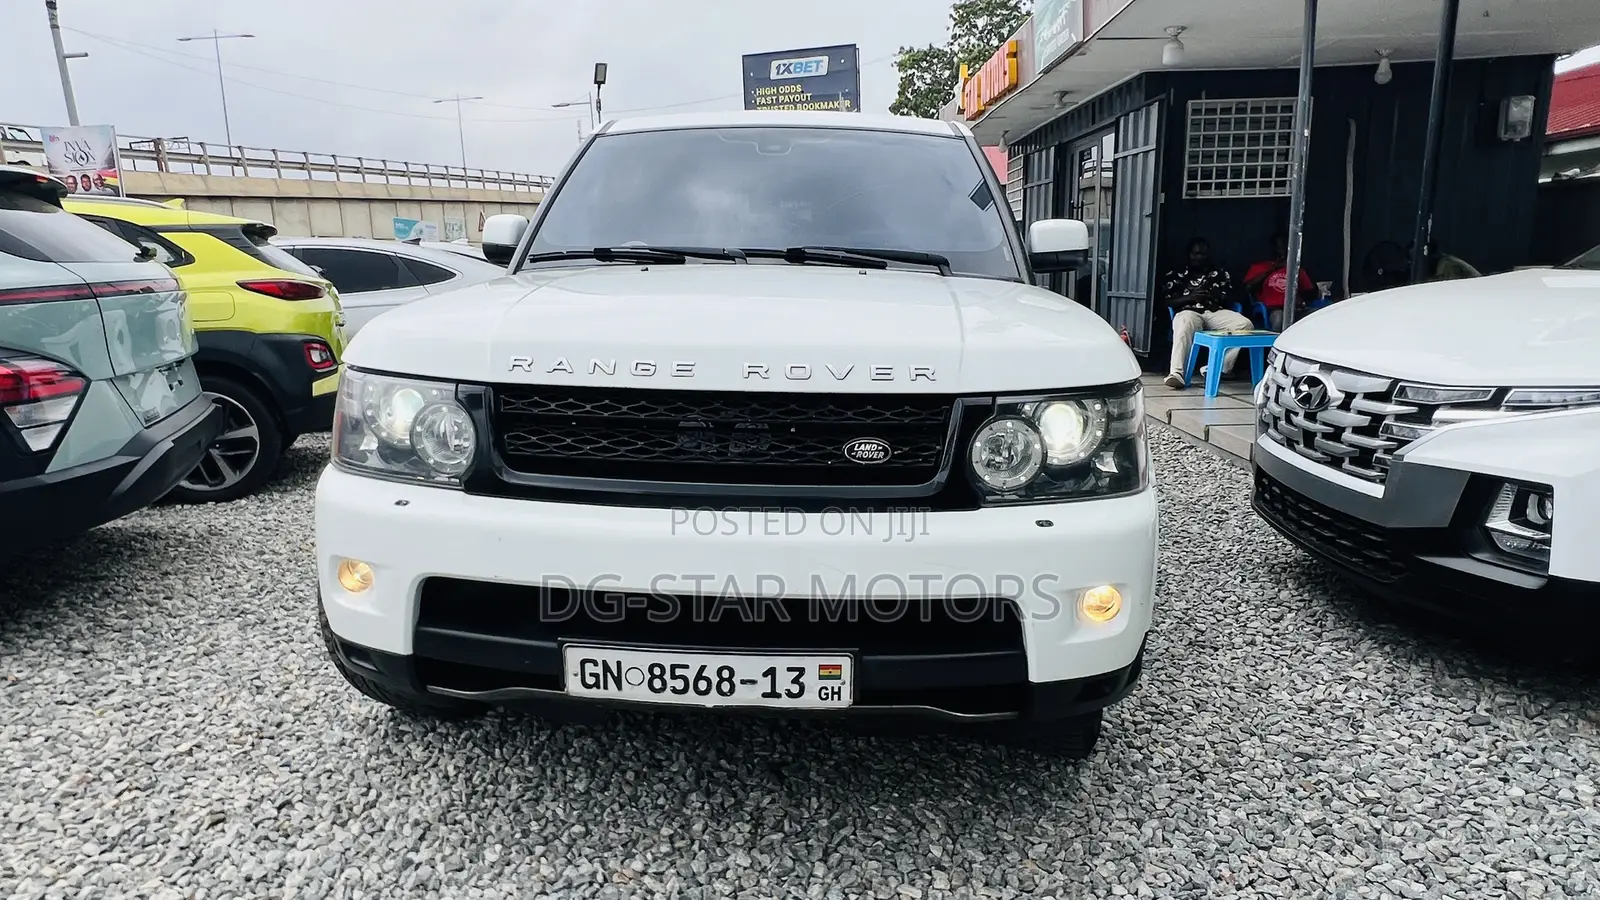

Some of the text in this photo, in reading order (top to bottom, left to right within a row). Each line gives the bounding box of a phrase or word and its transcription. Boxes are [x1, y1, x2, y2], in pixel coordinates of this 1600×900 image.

[775, 59, 824, 76] 1XBET
[756, 84, 802, 96] HIGH ODDS
[756, 93, 812, 106] FAST PAYOUT
[508, 355, 937, 381] RANGE ROVER
[817, 686, 842, 701] GH
